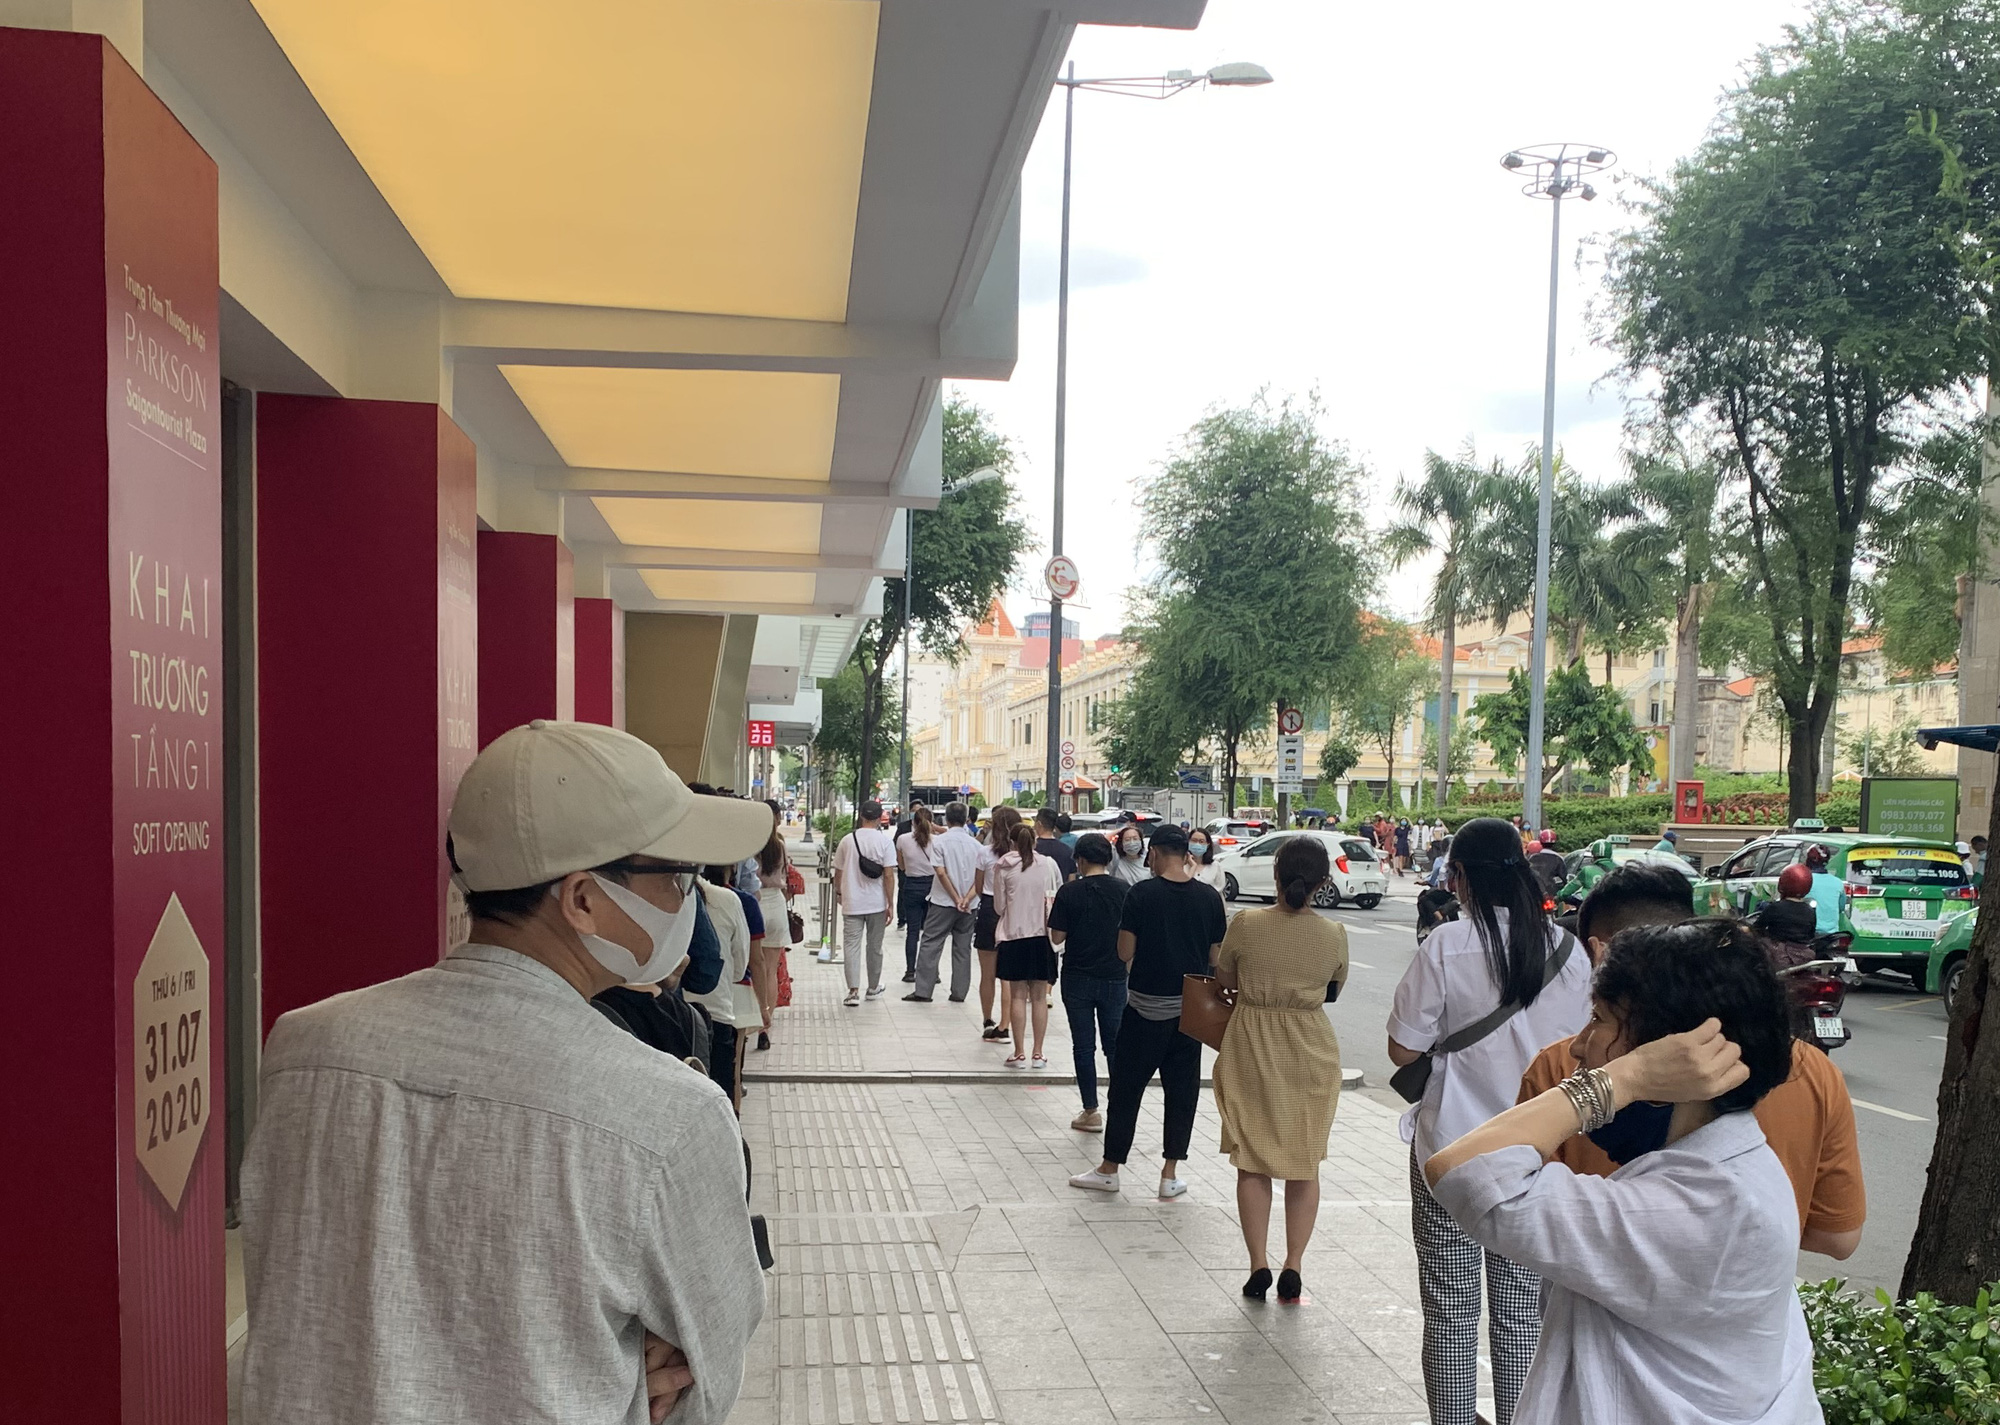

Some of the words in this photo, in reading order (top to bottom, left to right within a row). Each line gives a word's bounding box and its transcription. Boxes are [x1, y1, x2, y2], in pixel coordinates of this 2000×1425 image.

[124, 264, 146, 311] Trung
[125, 311, 207, 411] PARKSON
[126, 378, 183, 425] Saigontourist
[185, 416, 207, 454] Plaza
[129, 550, 209, 639] KHAI
[129, 649, 209, 717] TRƯƠNG
[133, 822, 161, 856] SOFT
[163, 820, 210, 853] OPENING
[1880, 810, 1945, 820] 0983.079.077
[1938, 869, 1959, 879] 1055
[1907, 901, 1921, 910] 51G
[170, 975, 176, 997] 6
[184, 969, 196, 992] FRI
[145, 1009, 202, 1083] 31.07
[146, 1076, 202, 1151] 2020
